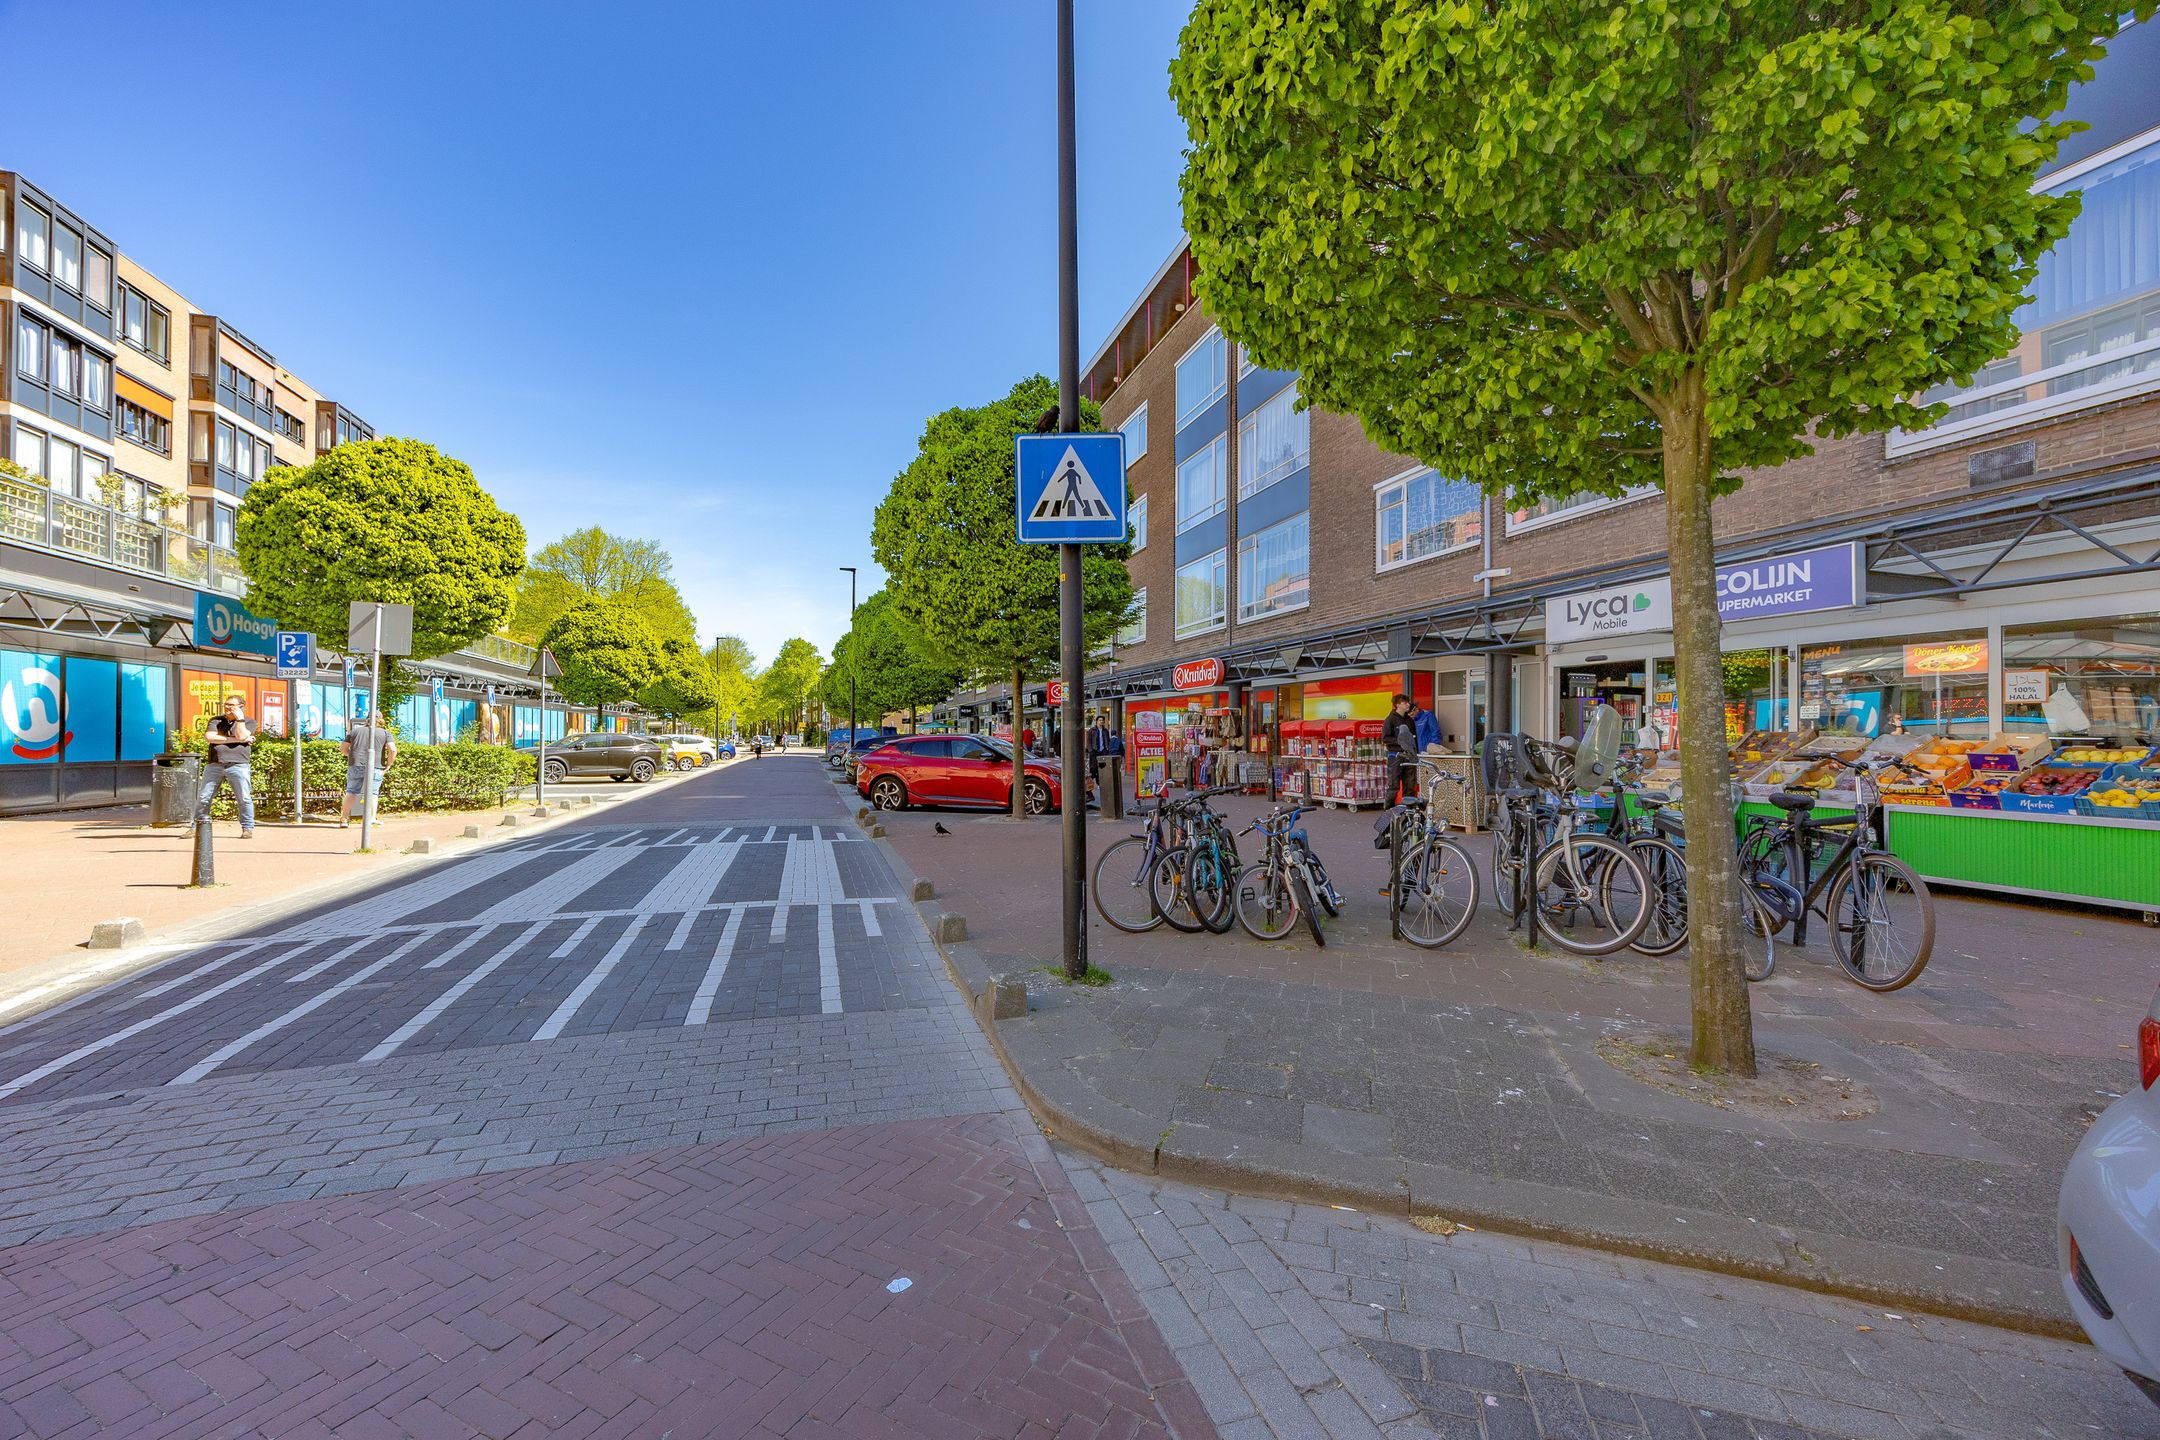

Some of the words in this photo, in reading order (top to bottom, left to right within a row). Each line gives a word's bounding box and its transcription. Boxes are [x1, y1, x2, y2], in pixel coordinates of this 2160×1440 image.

[1717, 588, 1813, 613] UPERMARKET
[1566, 595, 1628, 626] Lyca
[233, 613, 276, 640] Hoogv
[1592, 617, 1628, 631] Mobile
[281, 634, 296, 652] P
[1912, 647, 1945, 657] Döner
[1947, 644, 1981, 654] Kebab
[1803, 645, 1841, 661] MENU
[1183, 664, 1216, 684] Kruidvat
[1931, 697, 1988, 711] PIZZA
[1140, 747, 1164, 756] ACTIE!
